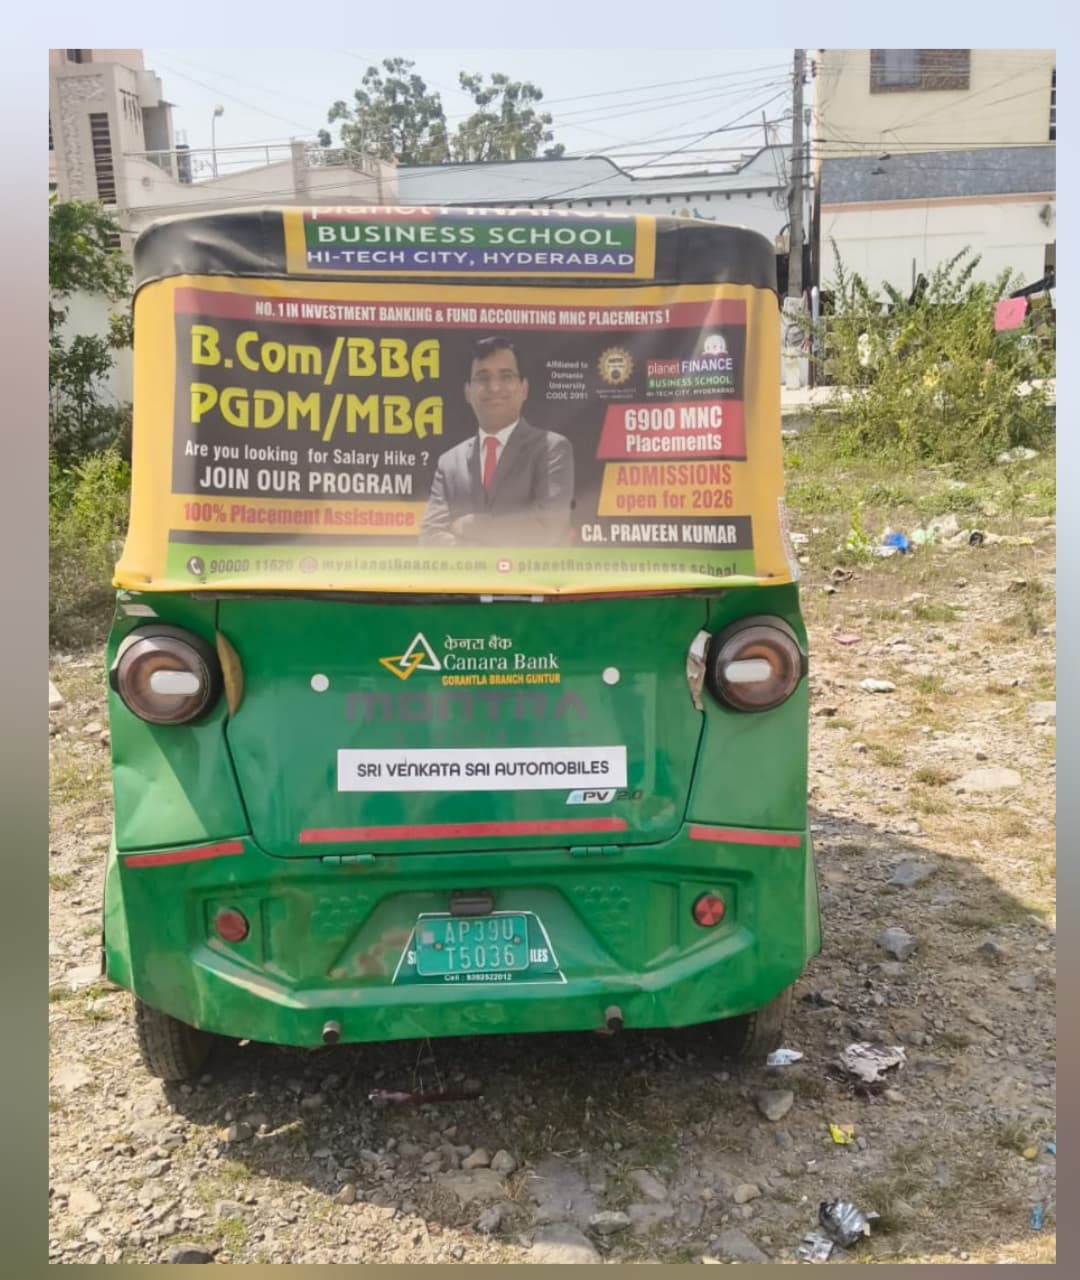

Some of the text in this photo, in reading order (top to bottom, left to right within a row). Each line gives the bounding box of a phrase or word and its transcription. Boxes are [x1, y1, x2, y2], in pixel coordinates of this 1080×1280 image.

[317, 225, 623, 246] BUSINESS SCHOOL
[307, 250, 635, 267] HI-TECH CITY, HYDERABAD
[255, 301, 670, 326] NO. 1 IN INVESTMENT BANKING & FUND ACCOUNTING MNC PLACEMENTS !
[190, 325, 440, 386] B.Com/BBA
[647, 358, 734, 378] planet FINANCE
[649, 375, 730, 388] BUSINESS SCHOOL
[190, 382, 444, 442] PGDM/MBA
[624, 405, 723, 431] 6900 MNC
[184, 440, 429, 468] Are you looking for Salary Hike ?
[625, 433, 723, 453] Placements
[200, 466, 413, 495] JOIN OUR PROGRAM
[616, 463, 732, 486] ADMISSIONS
[616, 489, 734, 512] open for 2026
[184, 503, 416, 527] 100% Placement Assistance
[581, 523, 737, 544] CA. PRAVEEN KUMAR
[443, 653, 559, 671] Canara Bank
[357, 761, 609, 777] SRI VENKATA SAI AUTOMOBILES
[583, 791, 609, 802] PV
[444, 919, 514, 944] AP39U
[445, 945, 515, 969] T5036
